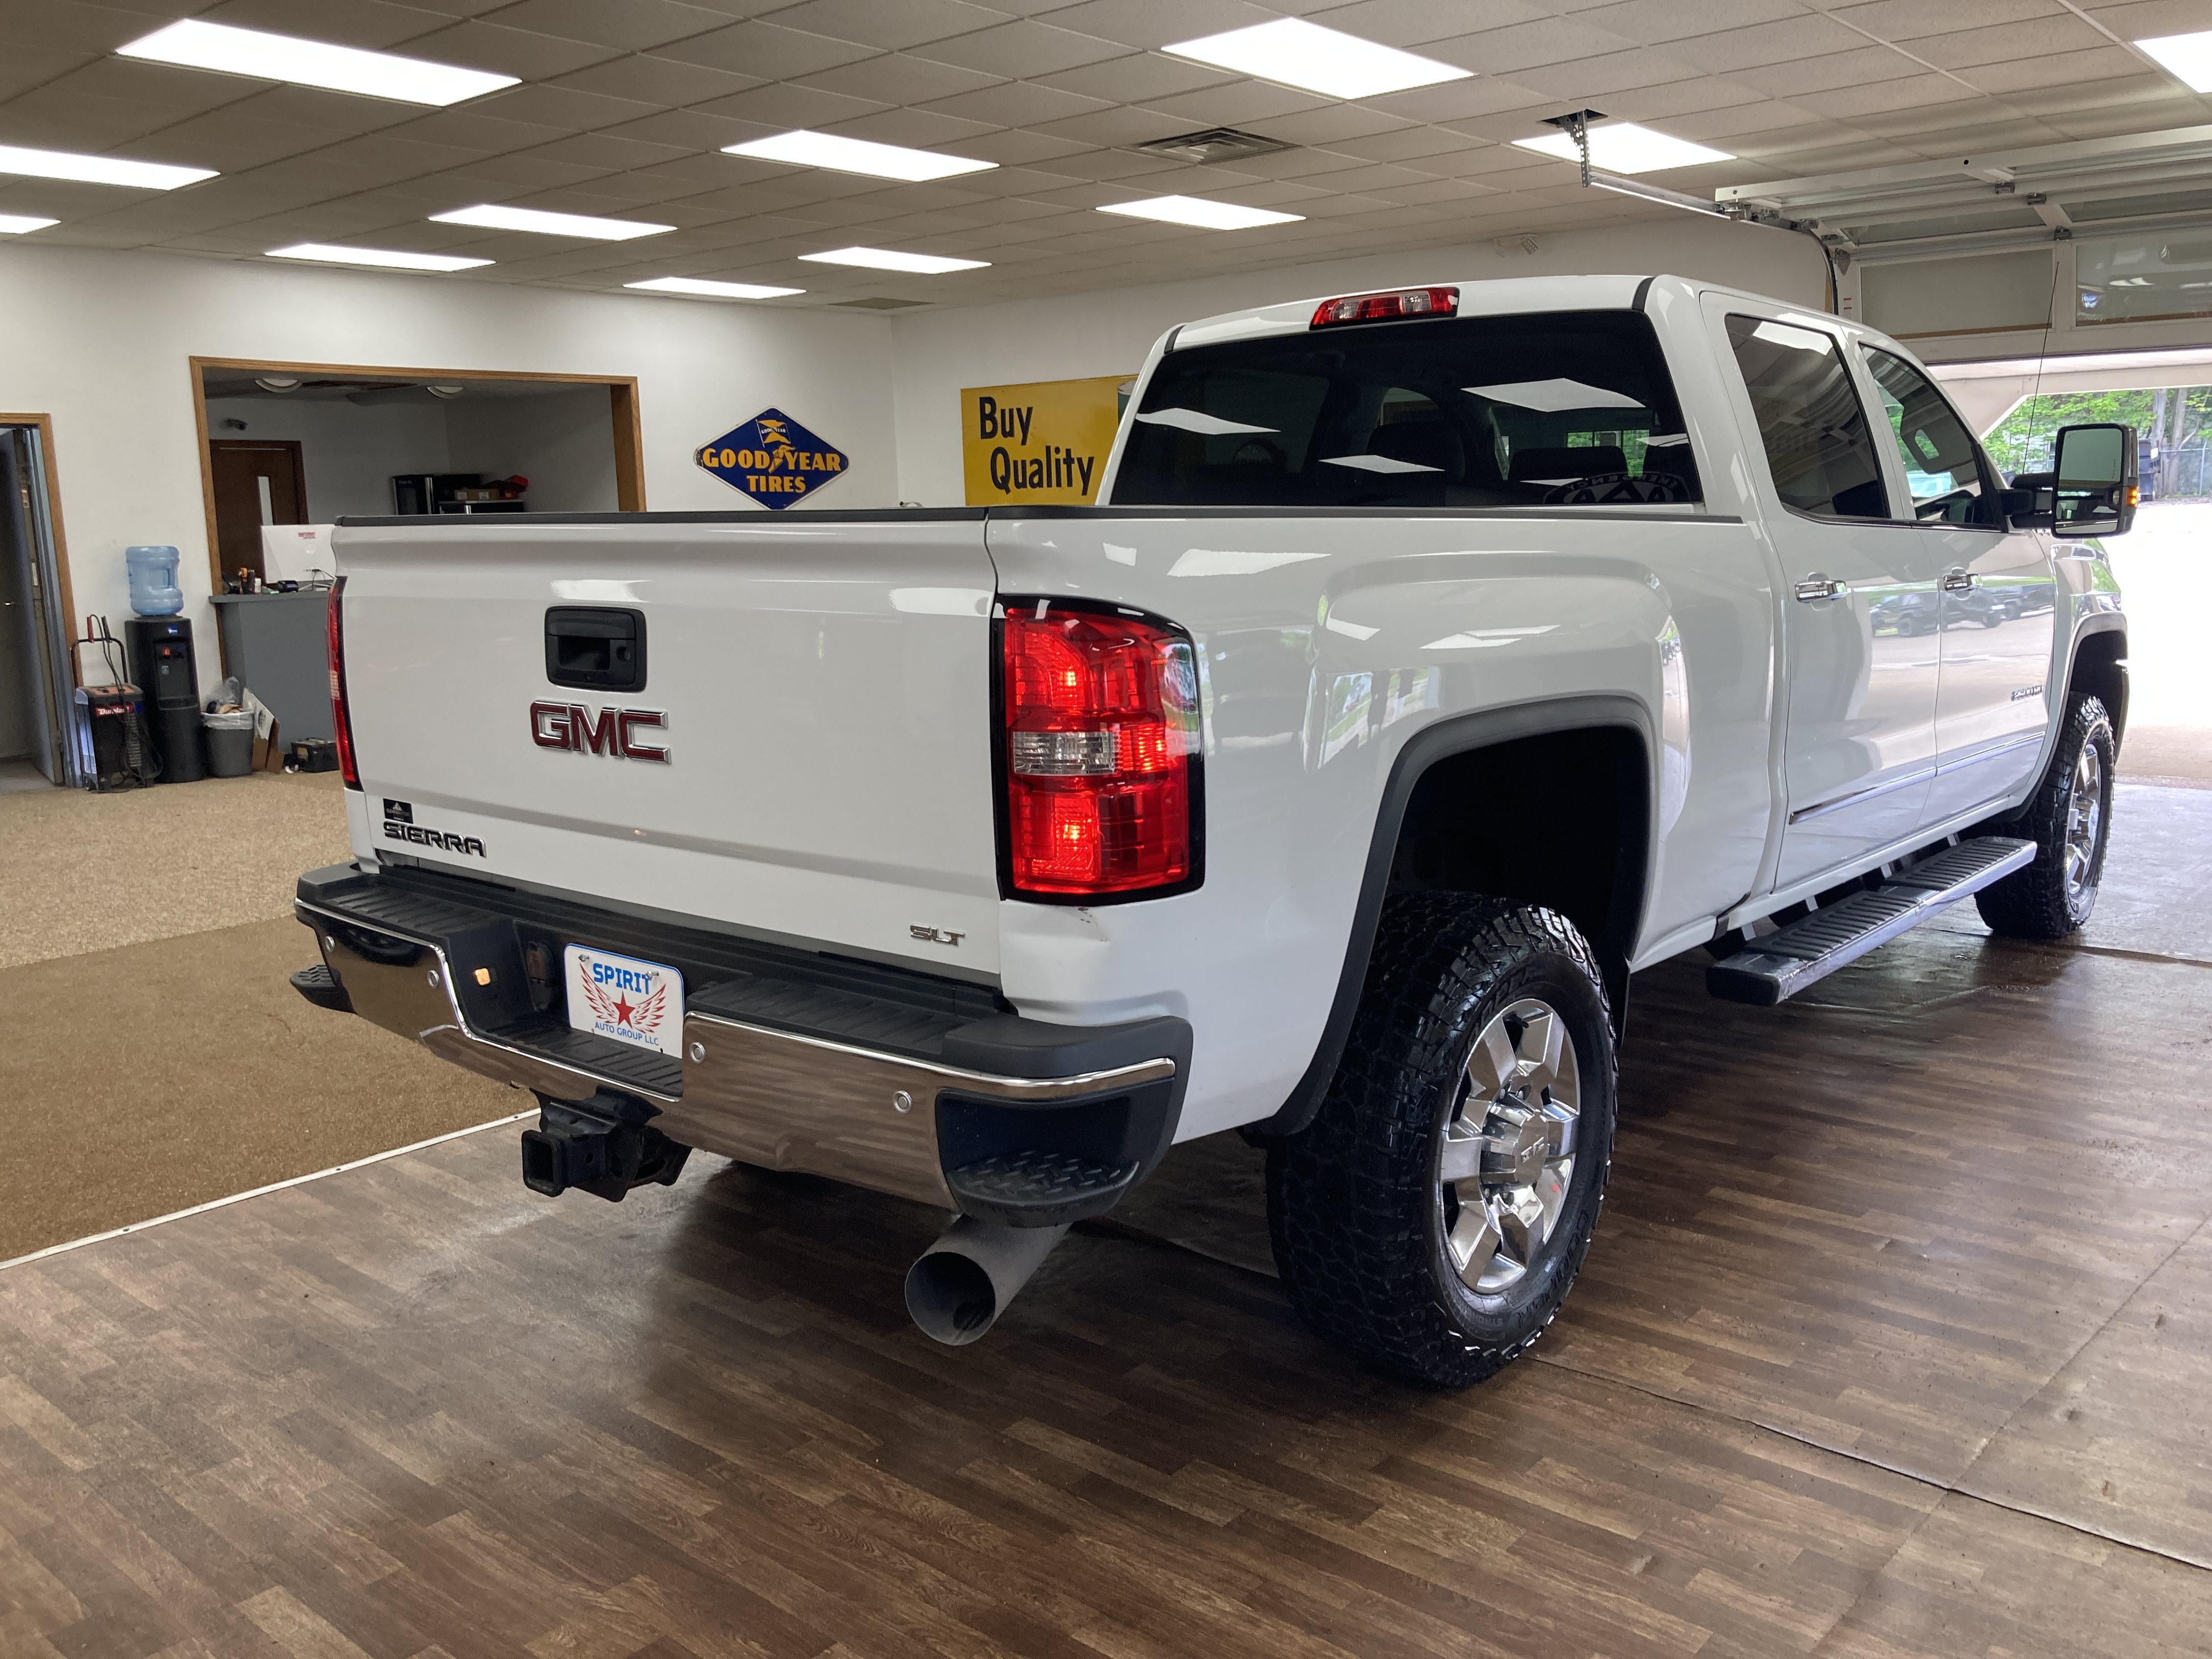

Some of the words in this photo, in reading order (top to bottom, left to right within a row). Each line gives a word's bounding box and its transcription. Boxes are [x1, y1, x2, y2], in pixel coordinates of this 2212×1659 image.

[979, 396, 1034, 445] Buy
[746, 475, 806, 493] TIRES
[990, 444, 1095, 496] Quality
[530, 700, 672, 764] GMC
[383, 821, 487, 859] SIERRA
[910, 924, 966, 946] SLT
[592, 963, 652, 995] SPIRIT
[595, 1021, 614, 1034] AUTO
[617, 1027, 643, 1041] GROUP
[645, 1035, 659, 1046] LLC
